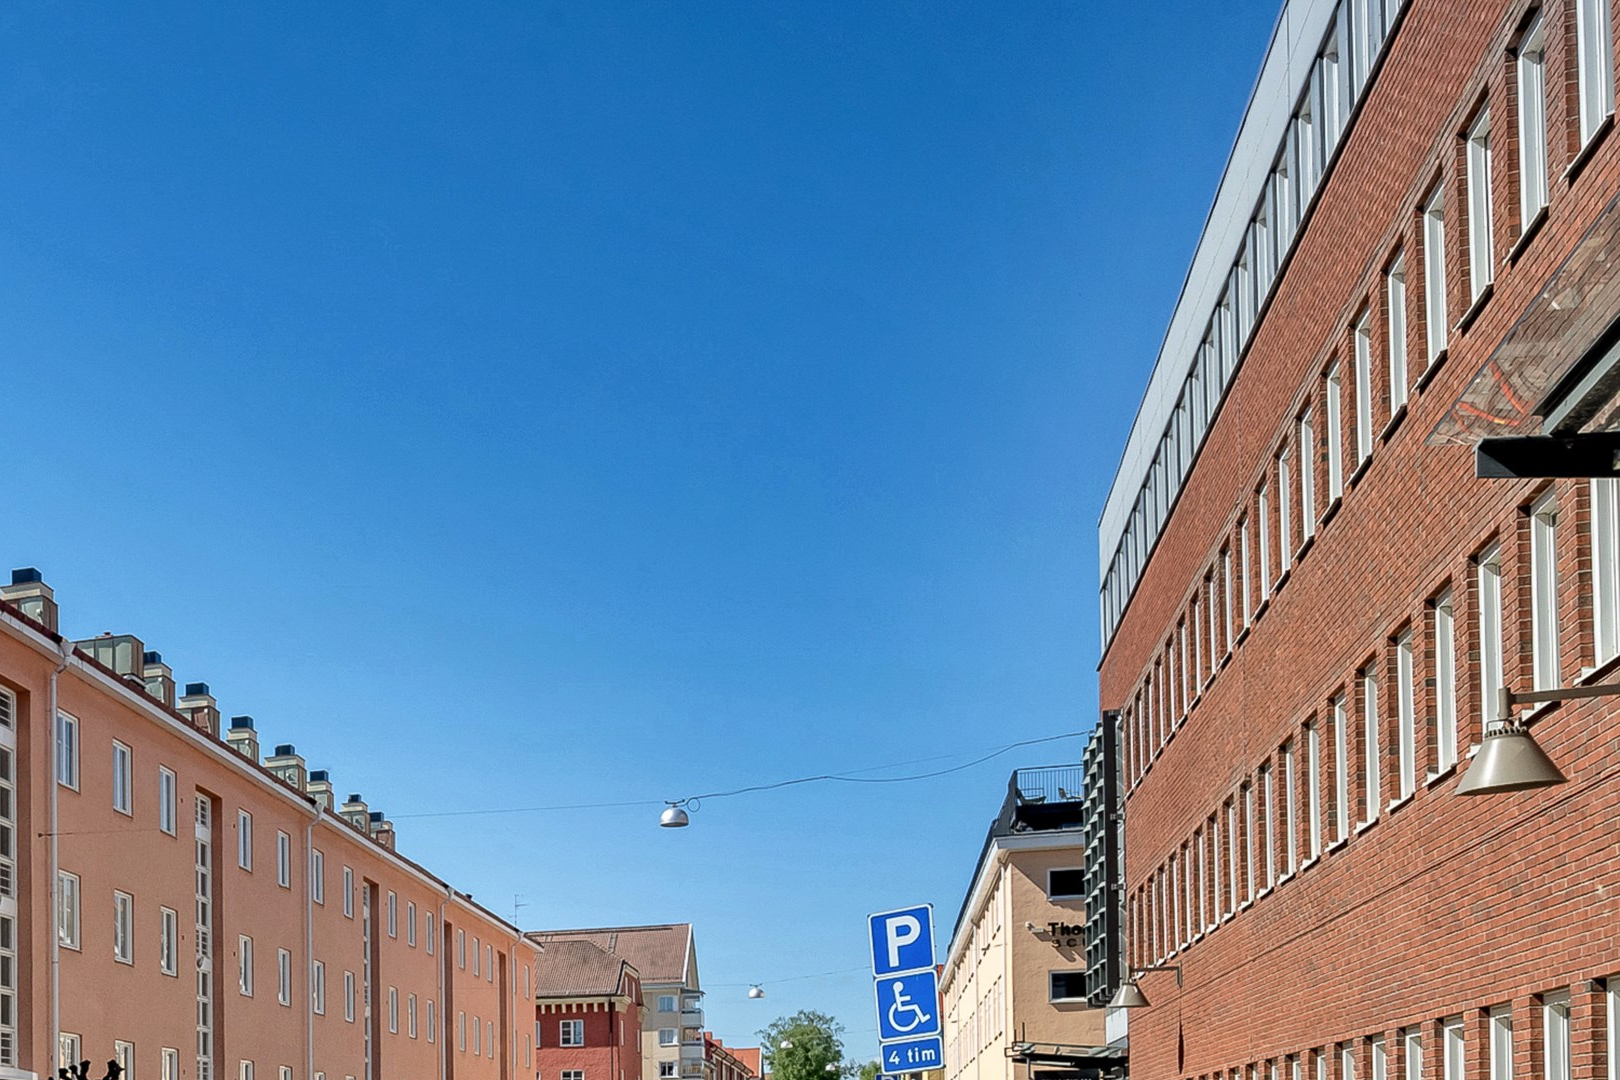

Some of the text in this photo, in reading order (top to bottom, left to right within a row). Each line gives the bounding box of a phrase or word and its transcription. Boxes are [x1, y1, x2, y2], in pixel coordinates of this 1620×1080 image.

[885, 915, 921, 968] P
[888, 1048, 936, 1065] 4 tim
